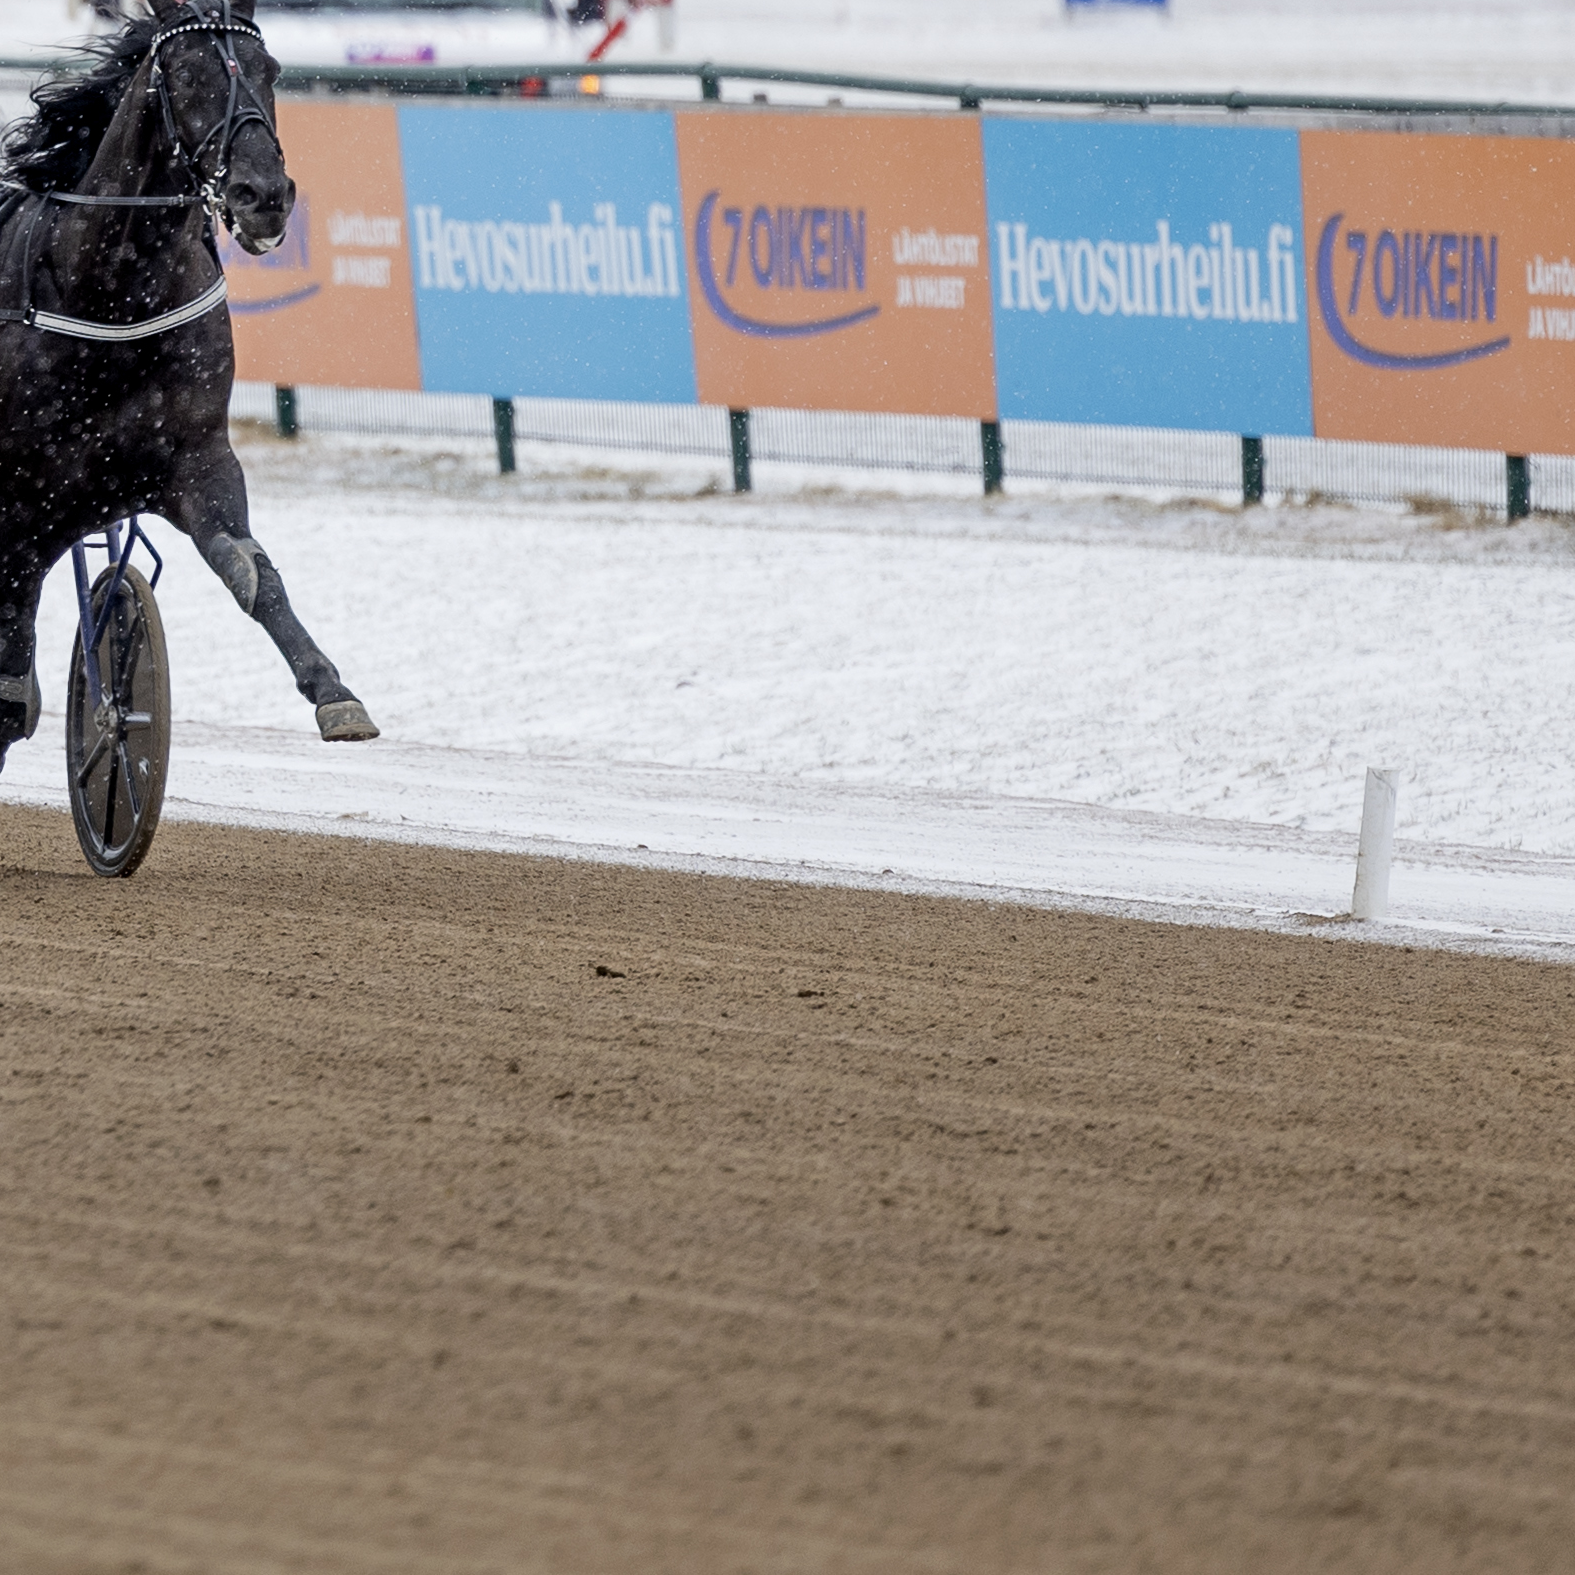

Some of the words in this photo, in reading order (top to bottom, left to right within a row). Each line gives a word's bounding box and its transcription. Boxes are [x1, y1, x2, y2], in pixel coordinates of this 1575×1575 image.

[413, 200, 680, 297] Hevosurheilu.fi
[749, 205, 868, 292] OIKEIN
[996, 219, 1298, 323] Hevosurheilu.fi
[1347, 232, 1366, 315] 7
[1373, 230, 1497, 323] OIKEIN
